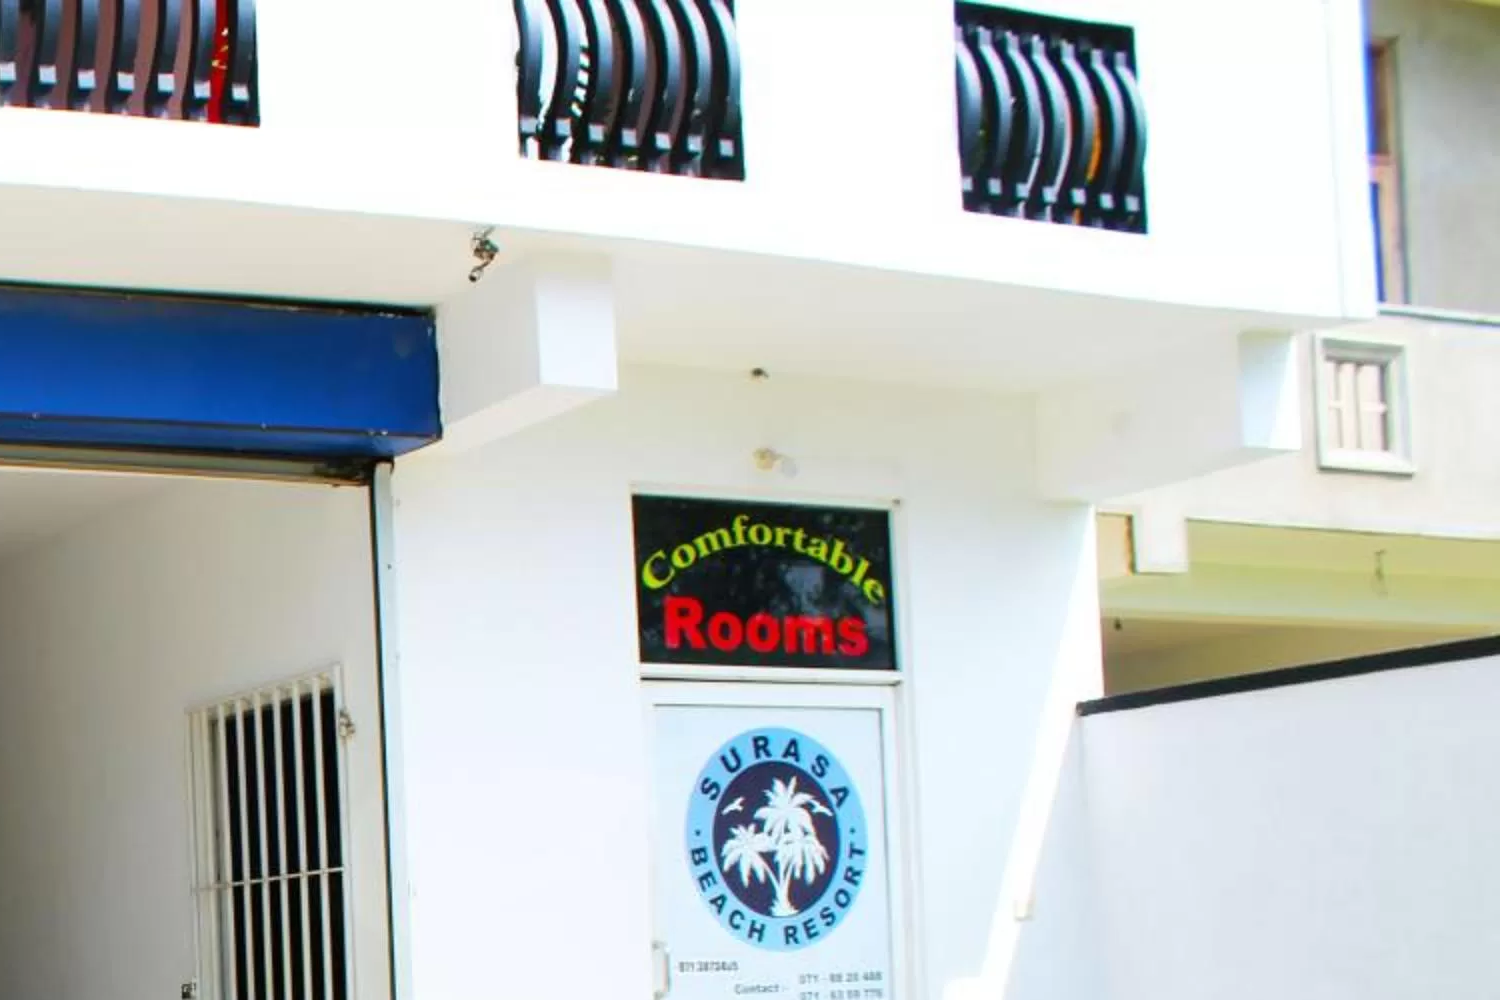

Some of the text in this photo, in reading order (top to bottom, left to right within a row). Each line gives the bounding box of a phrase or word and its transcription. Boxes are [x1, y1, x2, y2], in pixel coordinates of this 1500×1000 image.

[642, 514, 886, 605] Comfortable
[663, 595, 870, 657] Rooms
[700, 735, 850, 808] SURASA
[690, 843, 866, 945] BEACH RESORT
